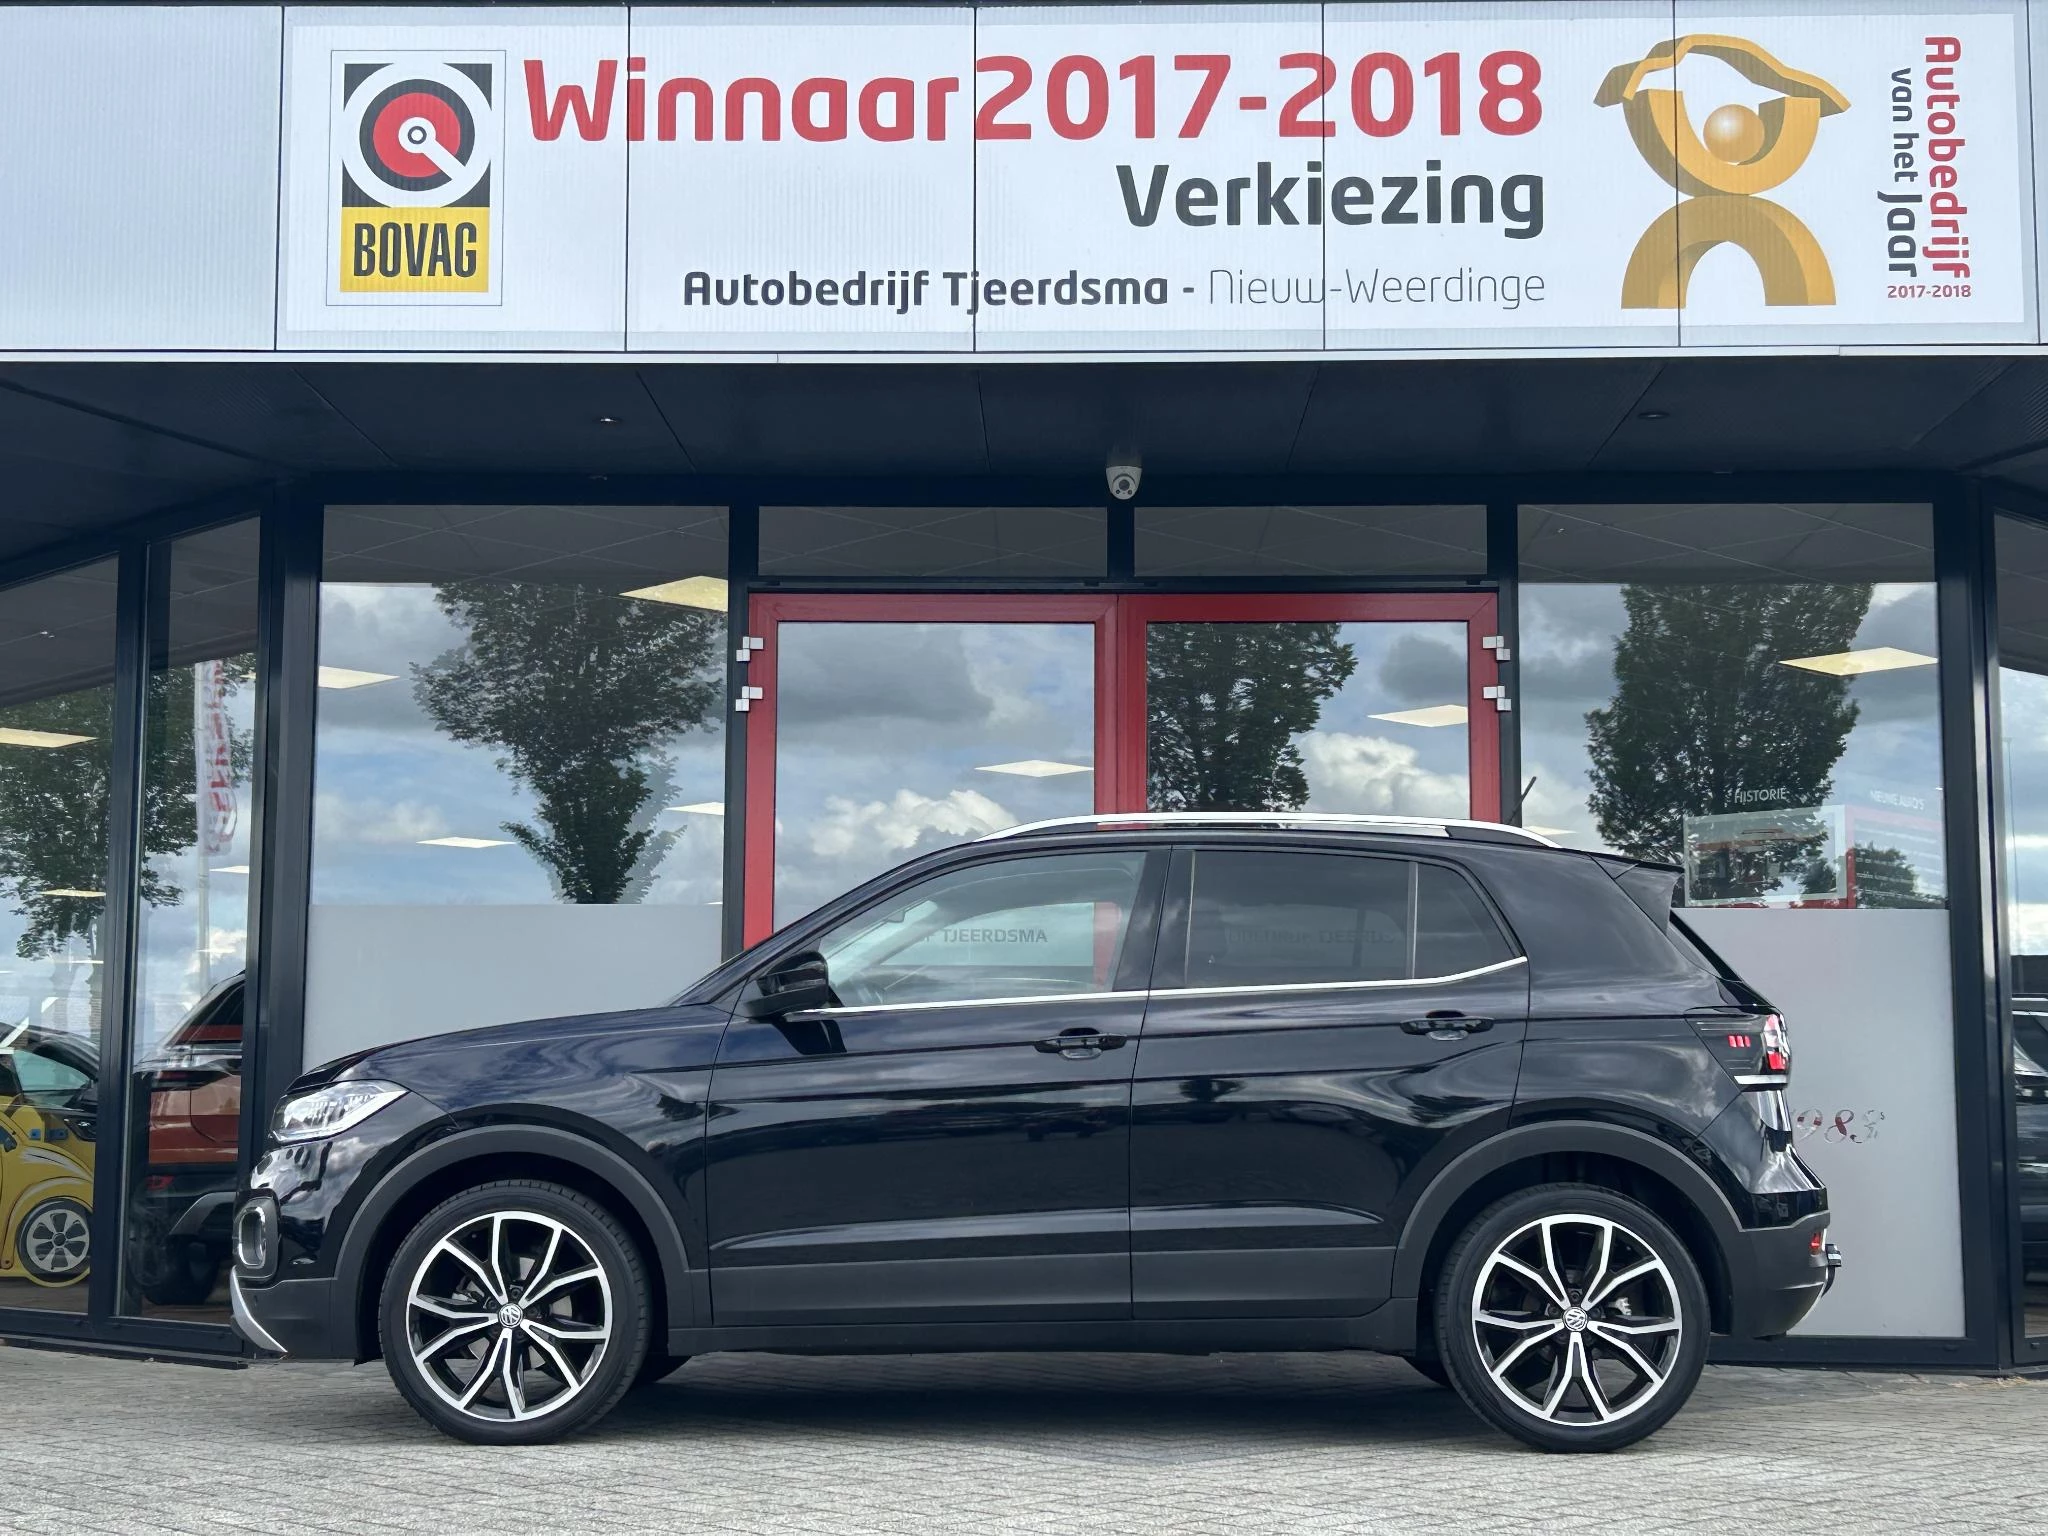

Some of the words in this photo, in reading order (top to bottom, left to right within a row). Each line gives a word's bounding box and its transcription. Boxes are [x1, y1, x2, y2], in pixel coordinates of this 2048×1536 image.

[524, 57, 959, 142] Winnaar
[974, 51, 1542, 140] 2017-2018
[1891, 67, 1913, 122] van
[1893, 133, 1920, 182] het
[1922, 36, 1971, 278] Autobedrijf
[1116, 159, 1543, 240] Verkiezing
[353, 222, 477, 278] BOVAG
[684, 270, 930, 315] Autobedrijf
[942, 269, 1168, 316] Tjeerdsma
[1210, 266, 1545, 310] Nieuw-Weerdinge
[1887, 284, 1972, 299] 2017-2018
[1734, 787, 1787, 805] HISTORIE
[943, 928, 1048, 943] TJEERDSMA
